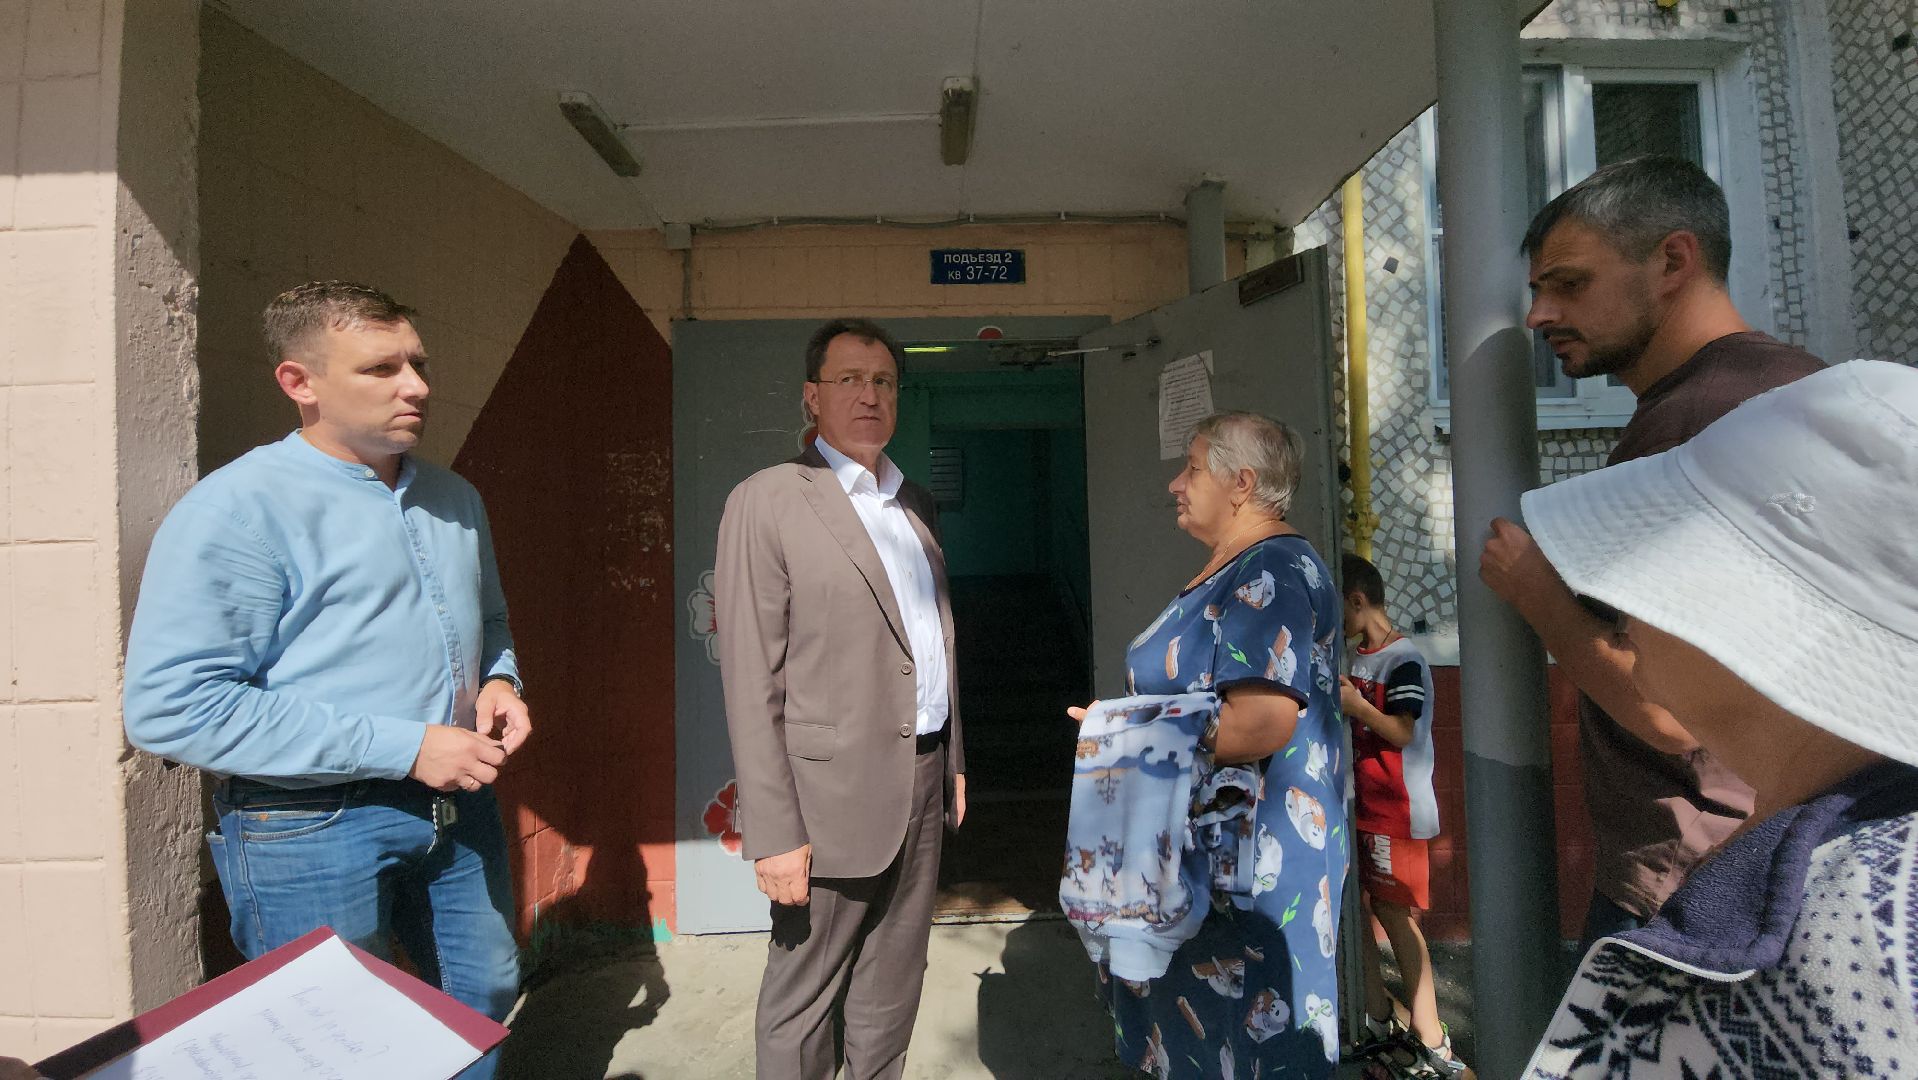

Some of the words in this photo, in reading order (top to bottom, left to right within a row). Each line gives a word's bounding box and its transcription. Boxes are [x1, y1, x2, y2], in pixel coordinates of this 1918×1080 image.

[944, 253, 1001, 264] ПОДЪЕЗД
[1004, 252, 1012, 263] 2
[966, 265, 1008, 280] 37-72
